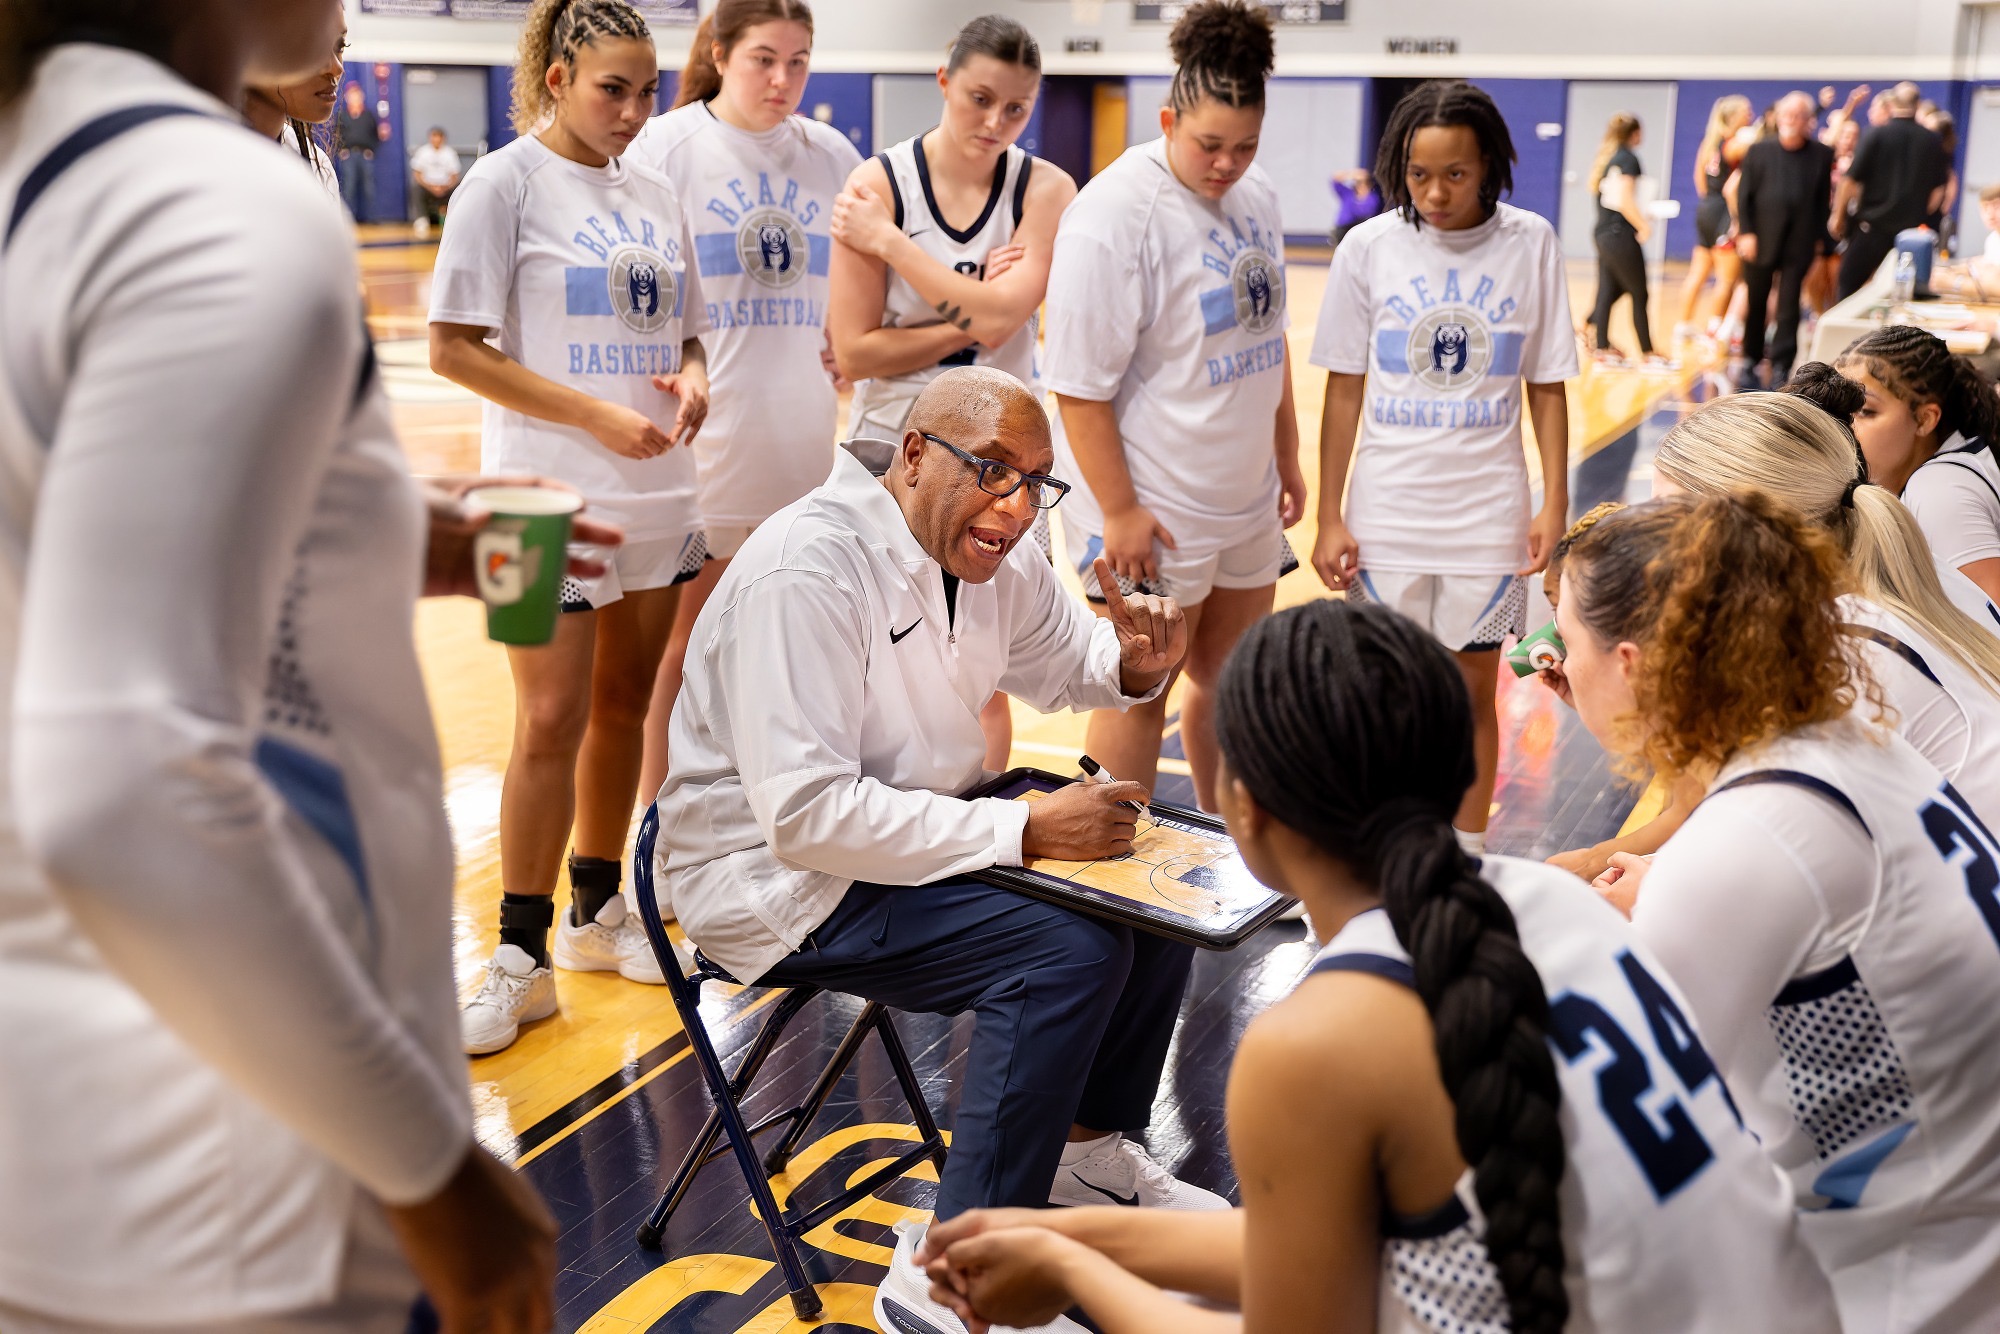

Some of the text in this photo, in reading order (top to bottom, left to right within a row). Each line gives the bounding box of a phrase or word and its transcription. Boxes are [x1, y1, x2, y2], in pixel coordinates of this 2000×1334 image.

[1385, 38, 1460, 54] WOMEN
[705, 171, 820, 228] BEARS
[573, 211, 680, 262] BEARS
[1203, 216, 1276, 279] BEARS
[1385, 268, 1516, 325] BEARS
[1547, 946, 1760, 1206] 24
